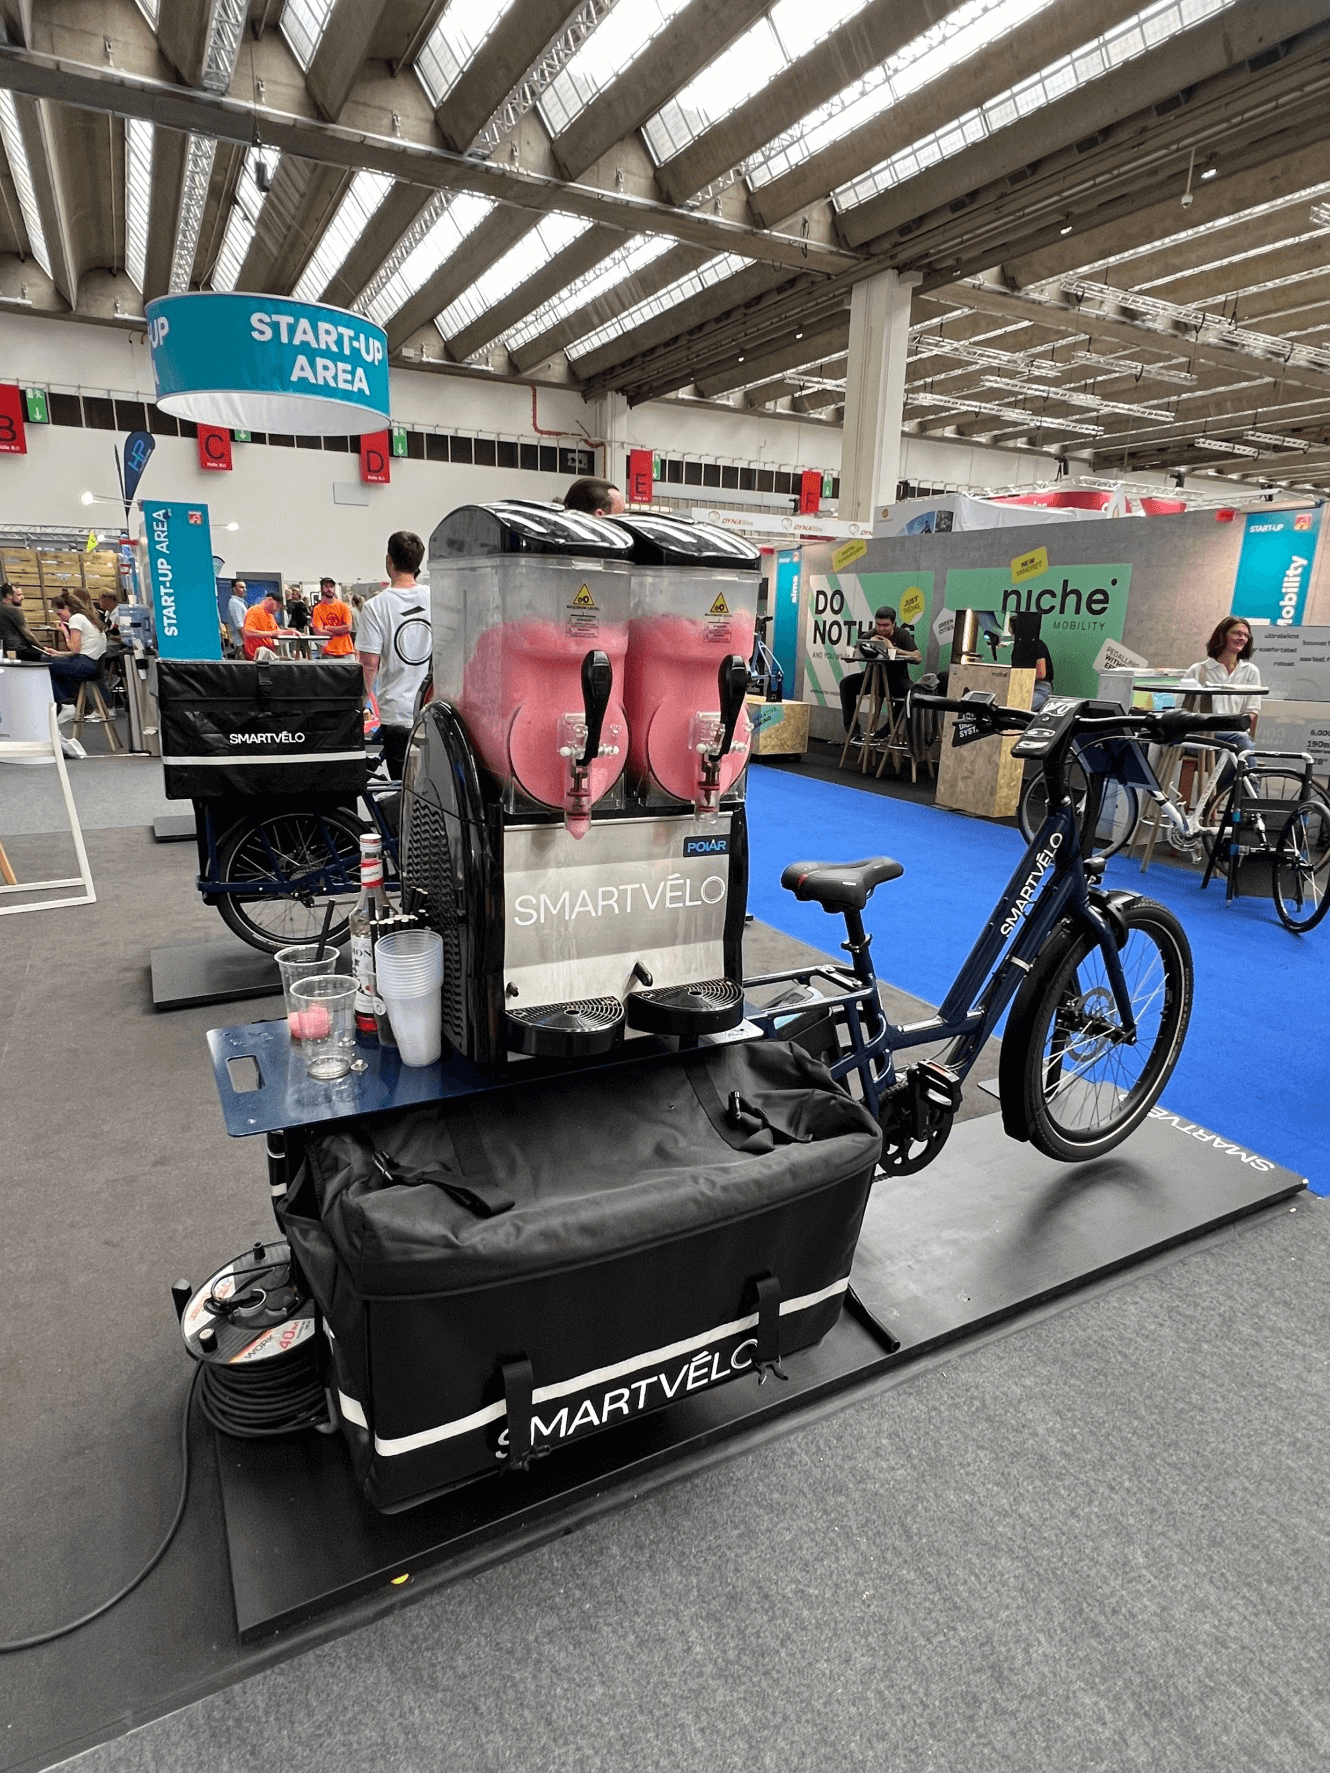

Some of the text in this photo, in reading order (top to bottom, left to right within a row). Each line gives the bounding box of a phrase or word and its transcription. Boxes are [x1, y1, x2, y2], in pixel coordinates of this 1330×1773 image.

[250, 312, 383, 366] START-UP
[290, 354, 371, 396] AREA
[204, 433, 225, 460] C
[366, 449, 384, 473] D
[635, 473, 646, 495] E
[1249, 523, 1284, 533] START-UP
[152, 509, 179, 637] START-UP AREA
[814, 589, 845, 615] DO
[1053, 620, 1106, 631] MOBILITY
[229, 731, 305, 744] SMARTVÉLO
[1000, 832, 1063, 937] SMARTVÉLO
[513, 872, 726, 926] SMARTVÉLO
[244, 1335, 275, 1359] WORK
